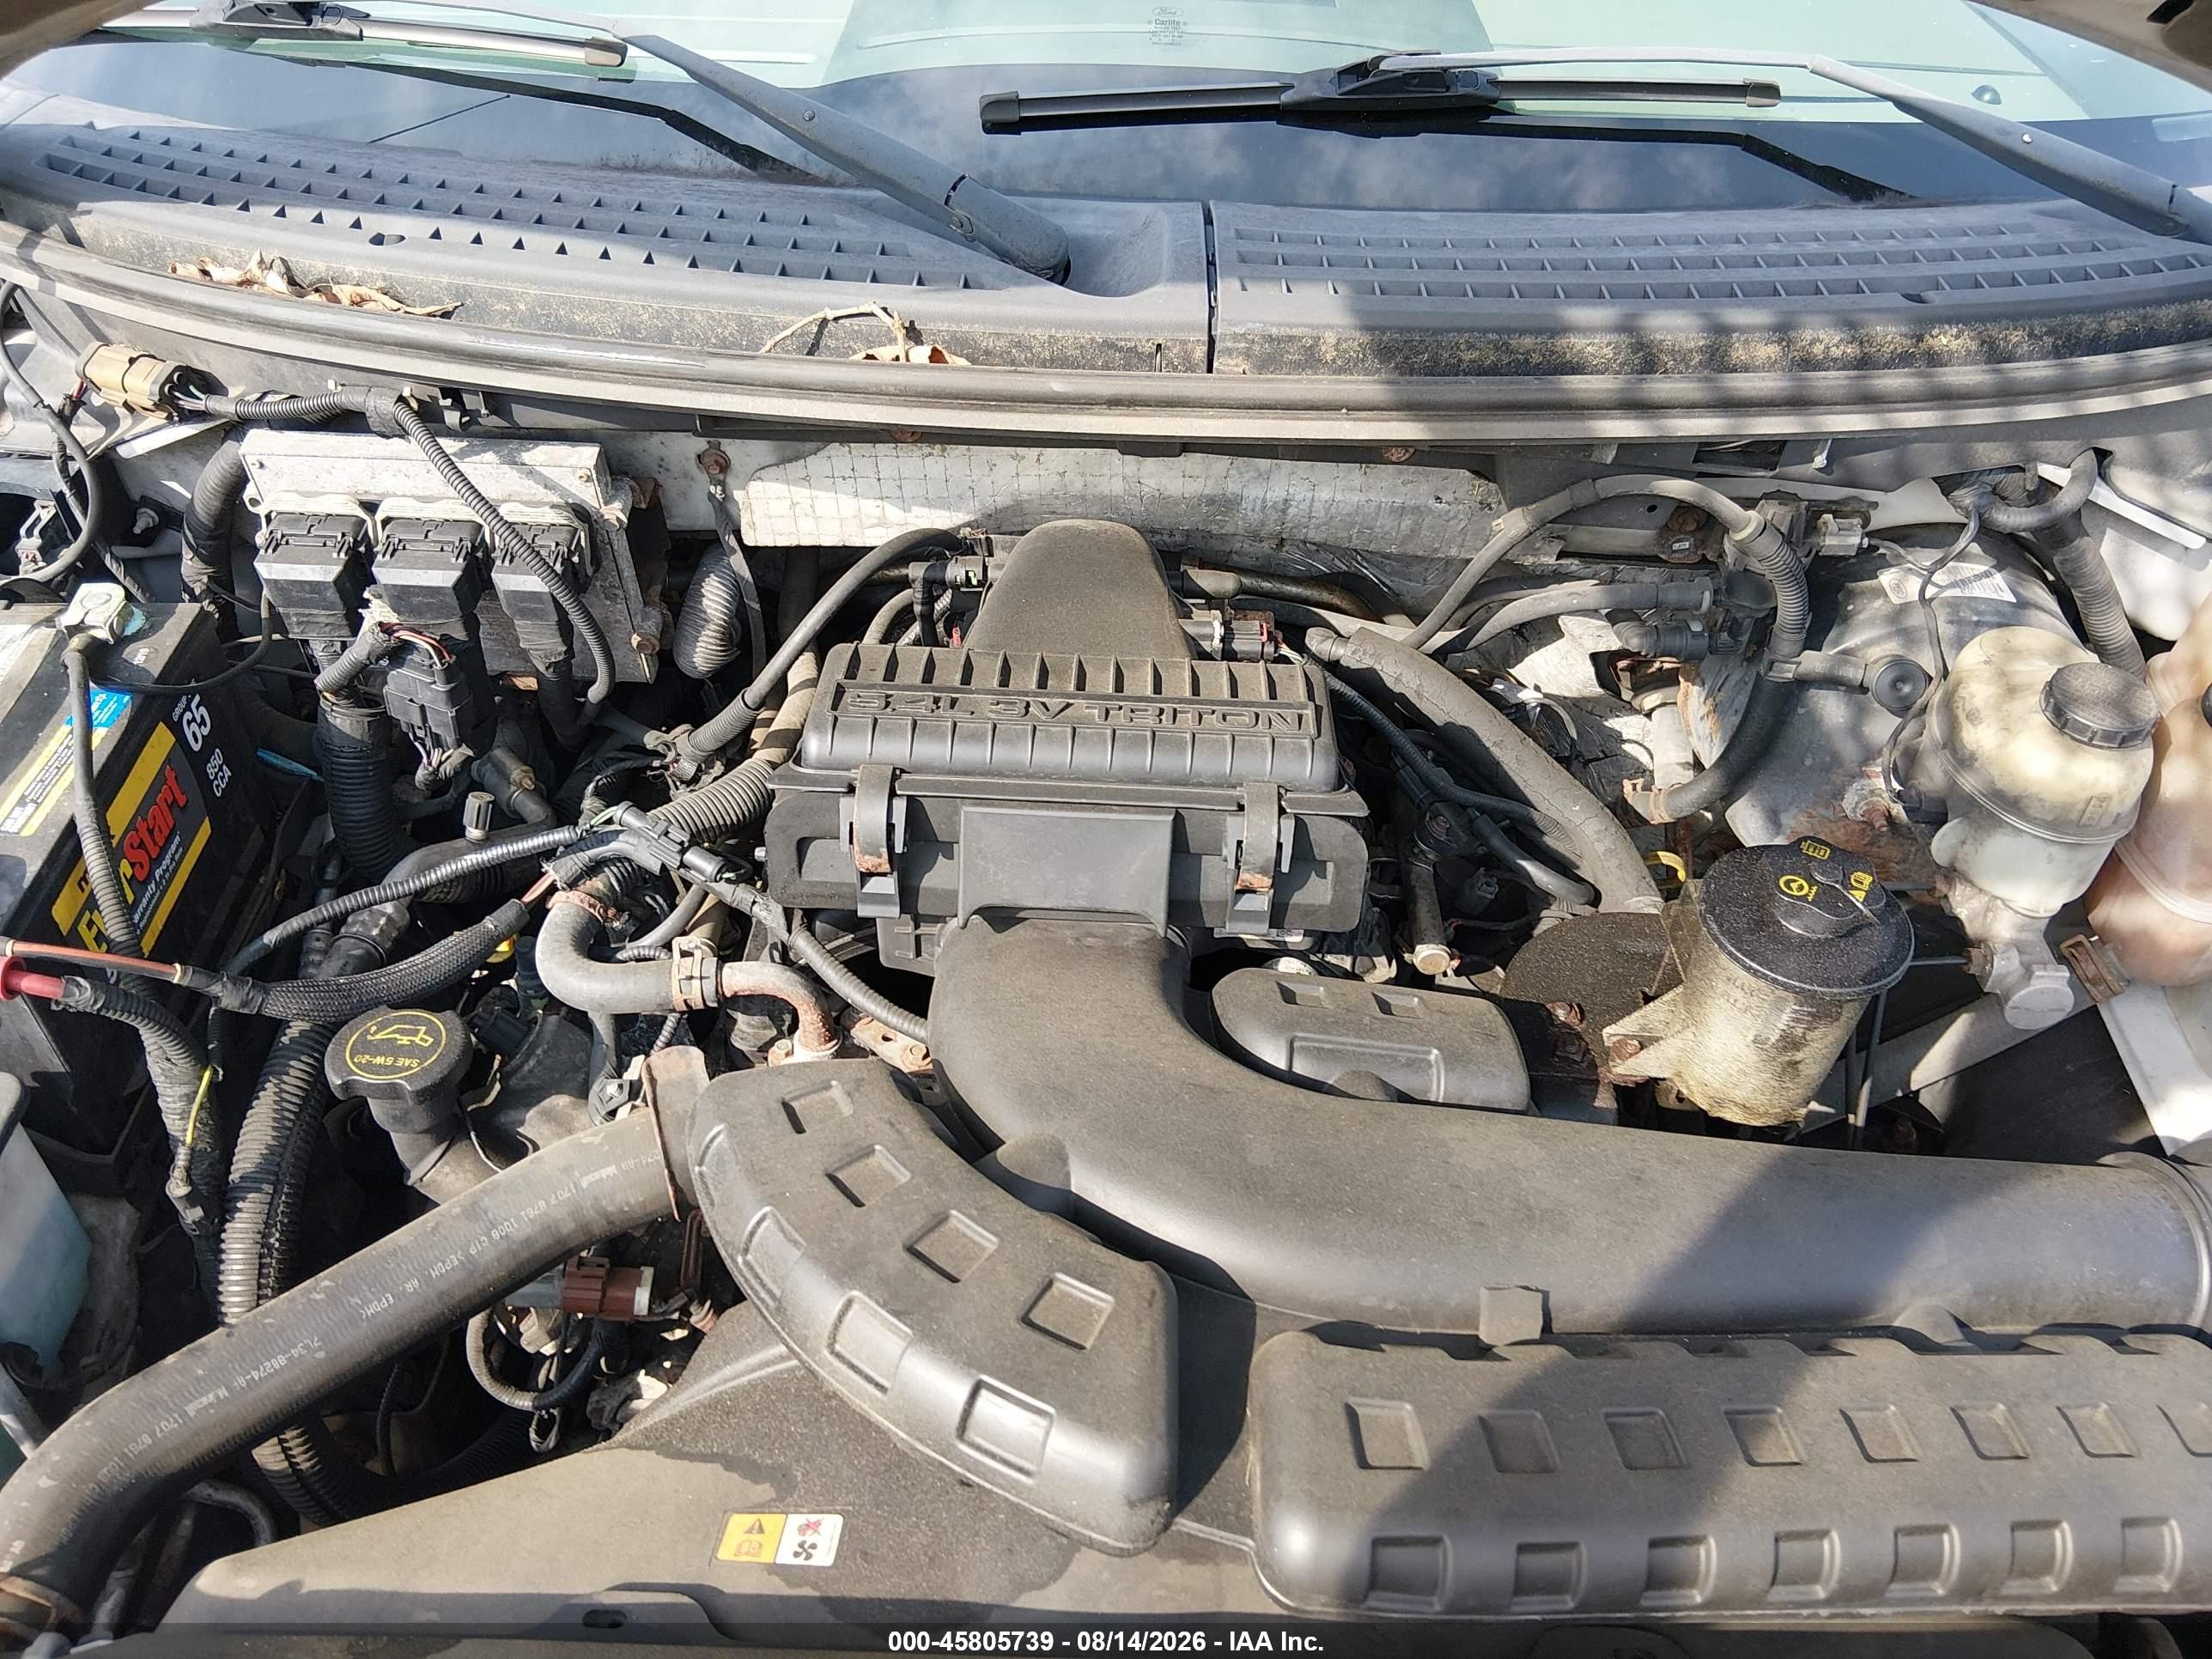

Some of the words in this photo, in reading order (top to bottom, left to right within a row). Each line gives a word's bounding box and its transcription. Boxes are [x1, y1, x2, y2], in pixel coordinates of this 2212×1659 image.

[182, 693, 211, 751] 65
[988, 697, 1073, 720] 3V
[1084, 701, 1305, 732] TRITON
[206, 748, 223, 780] 850
[212, 763, 232, 797] CCA
[354, 1054, 395, 1066] 5W-20
[395, 1057, 420, 1067] SAE
[550, 1182, 577, 1206] 1707
[520, 1200, 547, 1222] 8761
[491, 1218, 518, 1241] 1008
[155, 1413, 184, 1437] 1707
